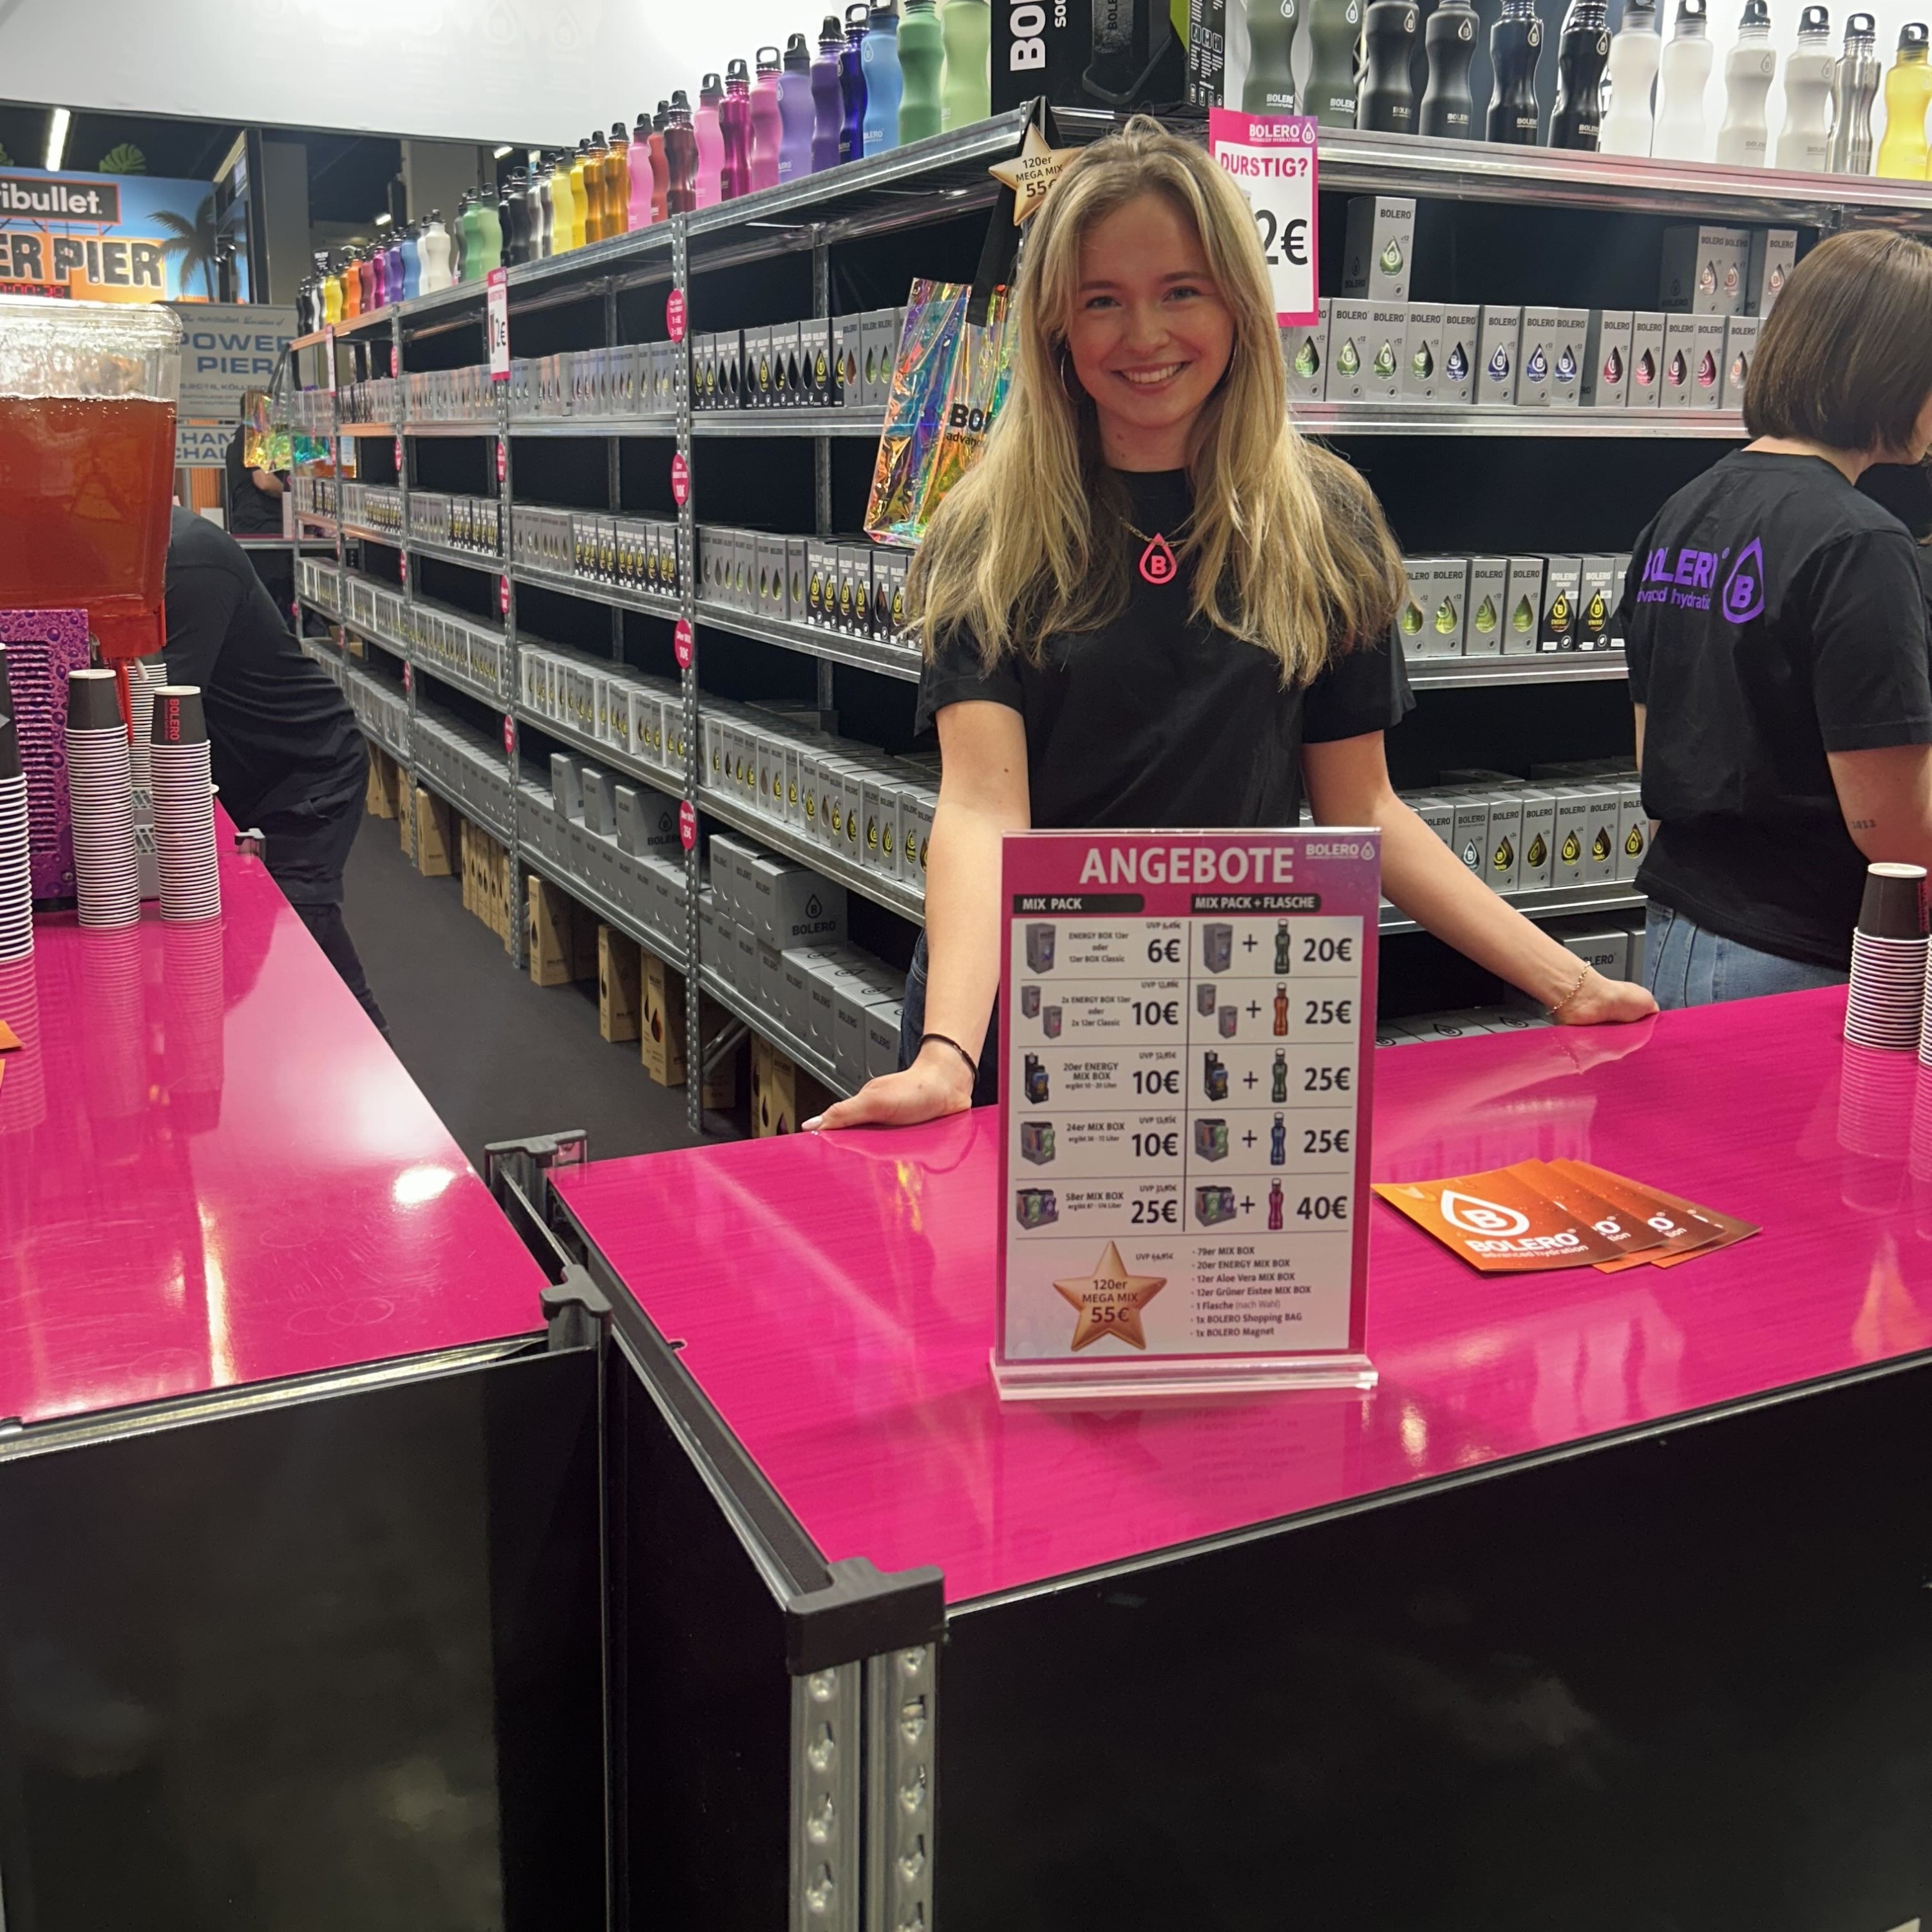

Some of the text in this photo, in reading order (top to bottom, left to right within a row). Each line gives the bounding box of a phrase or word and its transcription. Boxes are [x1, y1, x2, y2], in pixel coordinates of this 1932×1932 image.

[1249, 124, 1300, 138] BOLERO
[1023, 156, 1052, 169] 120er
[1221, 153, 1308, 177] DURSTIG?
[1016, 164, 1063, 182] MEGA MIX
[1380, 209, 1411, 219] BOLERO
[1255, 209, 1308, 265] 2€
[53, 238, 162, 287] PIER
[1336, 311, 1367, 320] BOLERO
[1374, 314, 1404, 323] BOLERO
[1411, 314, 1441, 323] BOLERO
[1446, 316, 1475, 325] BOLERO
[1489, 317, 1516, 327] BOLERO
[1637, 323, 1662, 332] BOLERO
[197, 357, 274, 374] PIER
[1434, 571, 1463, 579] BOLERO
[1513, 570, 1540, 578] BOLERO
[1551, 572, 1577, 580] BOLERO
[1586, 571, 1611, 580] BOLERO
[170, 698, 180, 741] BOLERO
[1526, 808, 1553, 819] BOLERO
[1591, 803, 1616, 812] BOLERO
[1458, 815, 1485, 824] BOLERO
[1493, 810, 1519, 820] BOLERO
[1305, 844, 1359, 855] BOLERO
[1079, 847, 1294, 884] ANGEBOTE
[1023, 898, 1082, 910] MIX PACK
[1195, 898, 1218, 909] MIX
[1220, 897, 1251, 908] PACK
[1264, 896, 1315, 908] FLASCHE
[792, 921, 836, 936] BOLERO
[1148, 939, 1180, 963] 6€
[1303, 938, 1352, 962] 20€
[1132, 1001, 1179, 1027] 10€
[1305, 1000, 1352, 1025] 25€
[1132, 1070, 1180, 1095] 10€
[1304, 1066, 1350, 1091] 25€
[1066, 1123, 1086, 1132] 24er
[1132, 1133, 1179, 1157] 10€
[1303, 1129, 1350, 1153] 25€
[1066, 1193, 1084, 1201] 58er
[1131, 1200, 1178, 1224] 25€
[1296, 1196, 1348, 1220] 40€
[1464, 1233, 1580, 1252] BOLERO
[1197, 1246, 1255, 1256] 79er MIX BOX
[1535, 1245, 1589, 1257] hydration
[1197, 1259, 1290, 1269] 20er ENERGY MIX BOX
[1197, 1274, 1214, 1283] 12er
[1216, 1274, 1234, 1283] Aloe
[1236, 1274, 1256, 1282] Vera
[1258, 1273, 1274, 1282] MIX
[1094, 1279, 1128, 1291] 120er
[1197, 1285, 1311, 1296] 12er Grüner Eistee MIX BOX
[1082, 1293, 1138, 1303] MEGA MIX
[1202, 1301, 1233, 1310] Flasche
[1235, 1300, 1256, 1311] (nach
[1258, 1299, 1281, 1310] Wahl)
[1091, 1306, 1130, 1323] 55€
[1207, 1315, 1241, 1323] BOLERO
[1243, 1313, 1282, 1325] Shopping
[1285, 1312, 1302, 1321] BAG
[1207, 1329, 1240, 1337] BOLERO
[1242, 1327, 1274, 1338] Magnet
